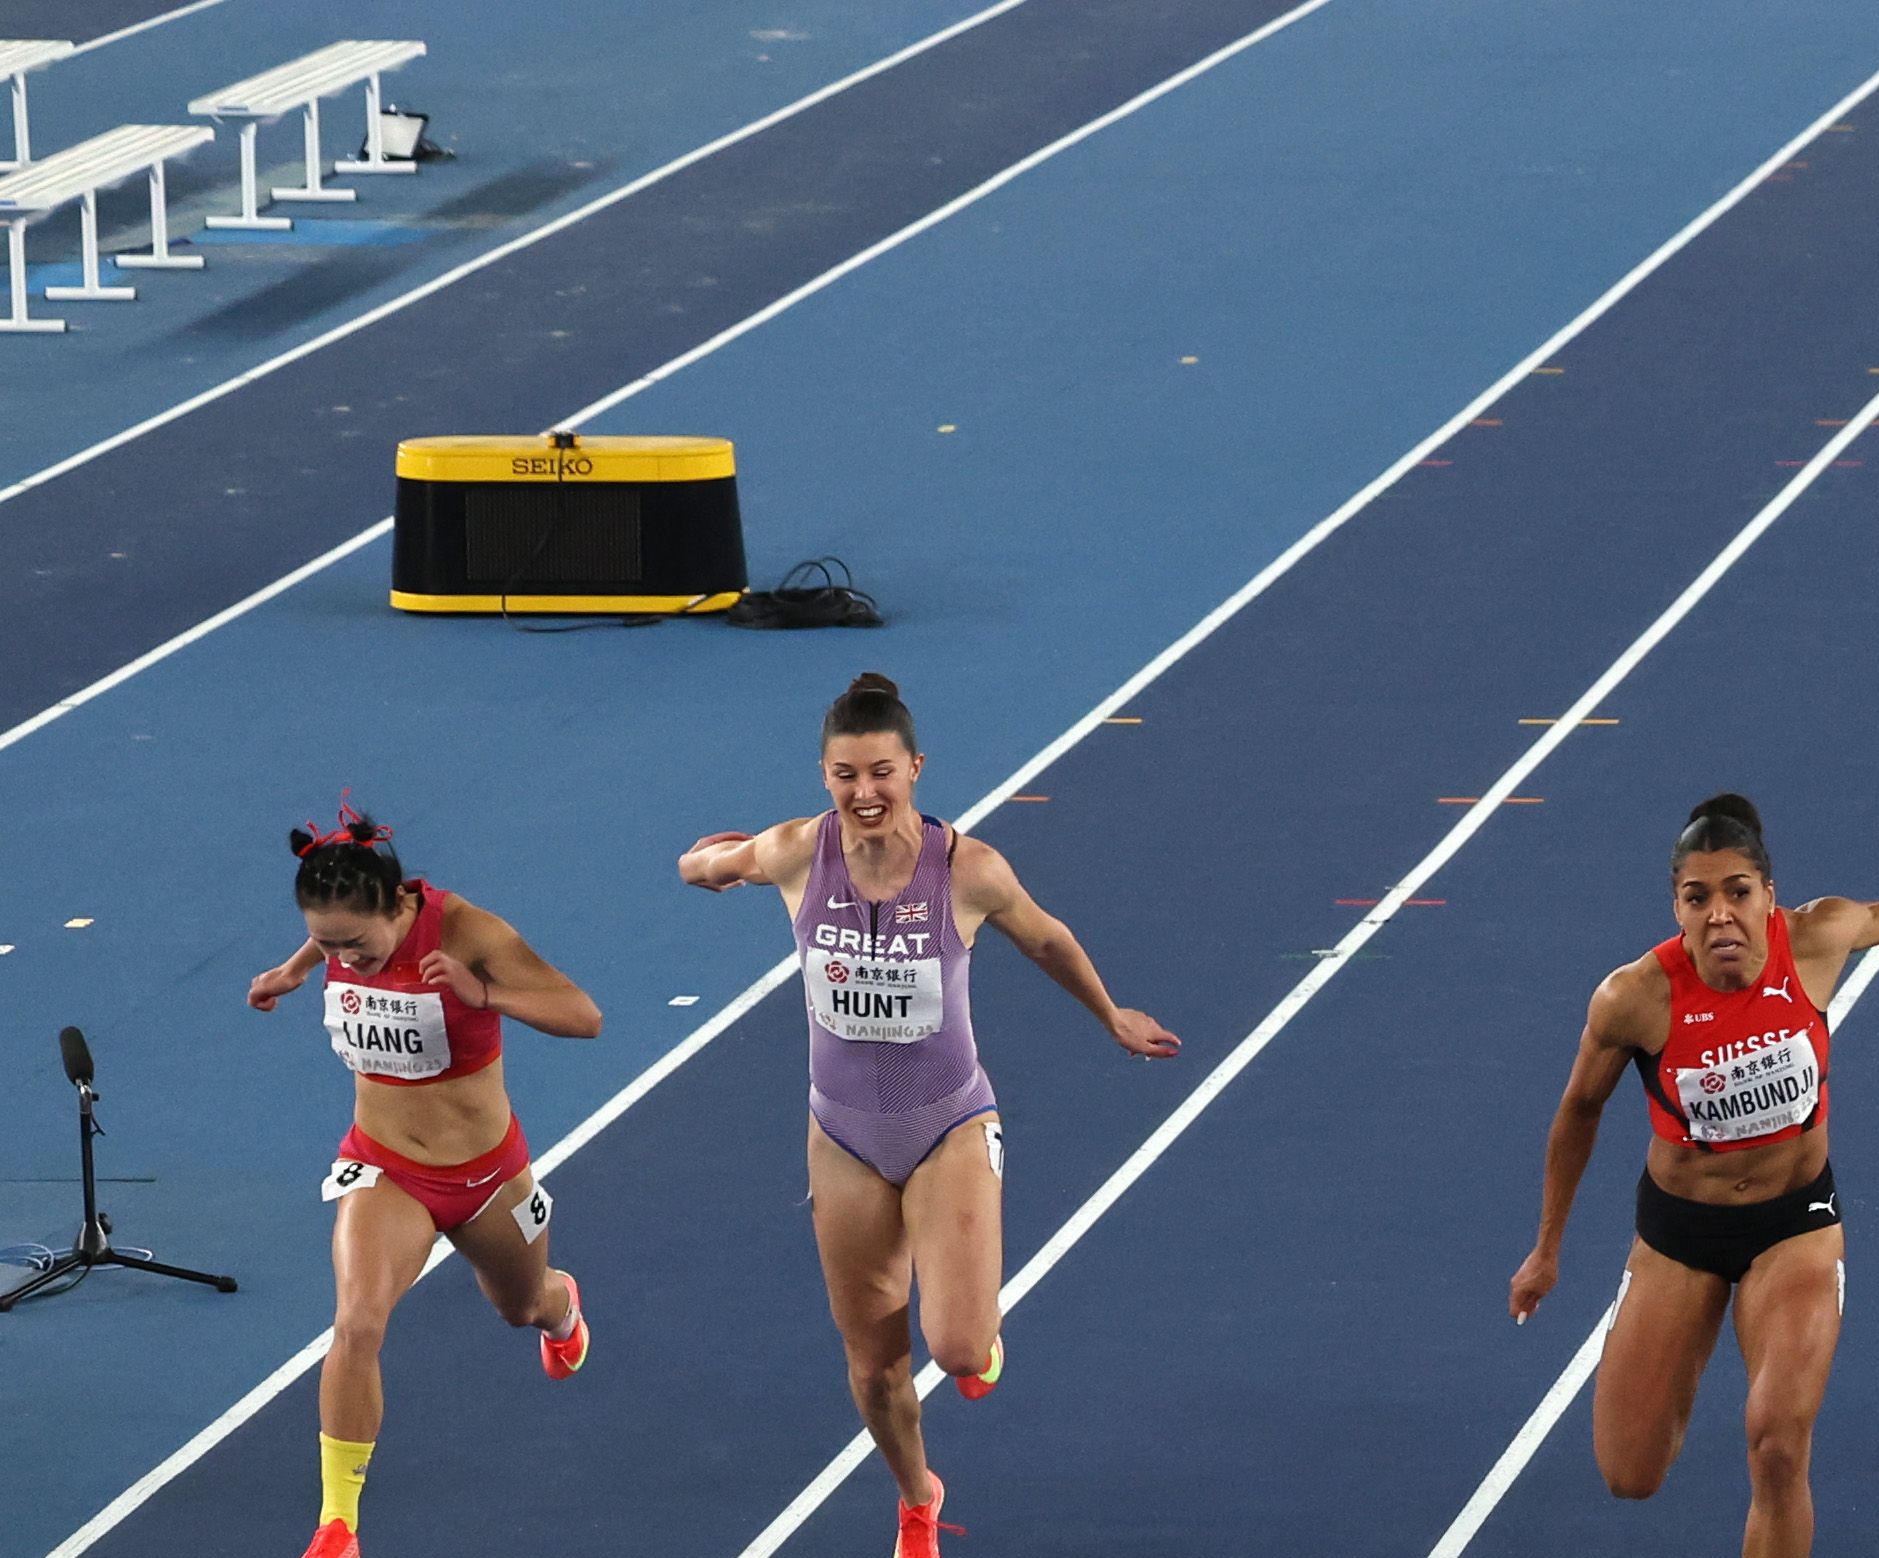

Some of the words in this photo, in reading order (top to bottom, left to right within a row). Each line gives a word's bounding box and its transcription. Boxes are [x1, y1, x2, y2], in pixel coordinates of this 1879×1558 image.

[511, 458, 593, 475] SEIKO
[815, 923, 930, 954] GREAT
[855, 966, 918, 983] 南京银行
[832, 989, 913, 1019] HUNT
[1694, 1012, 1715, 1022] UBS
[343, 1021, 424, 1054] LIANG
[846, 1024, 914, 1040] NANJING
[916, 1025, 934, 1037] 25
[1730, 1048, 1792, 1080] 南京银行
[1689, 1066, 1813, 1121] KAMBUNDJI
[336, 1163, 364, 1187] 8
[530, 1192, 547, 1225] 8
